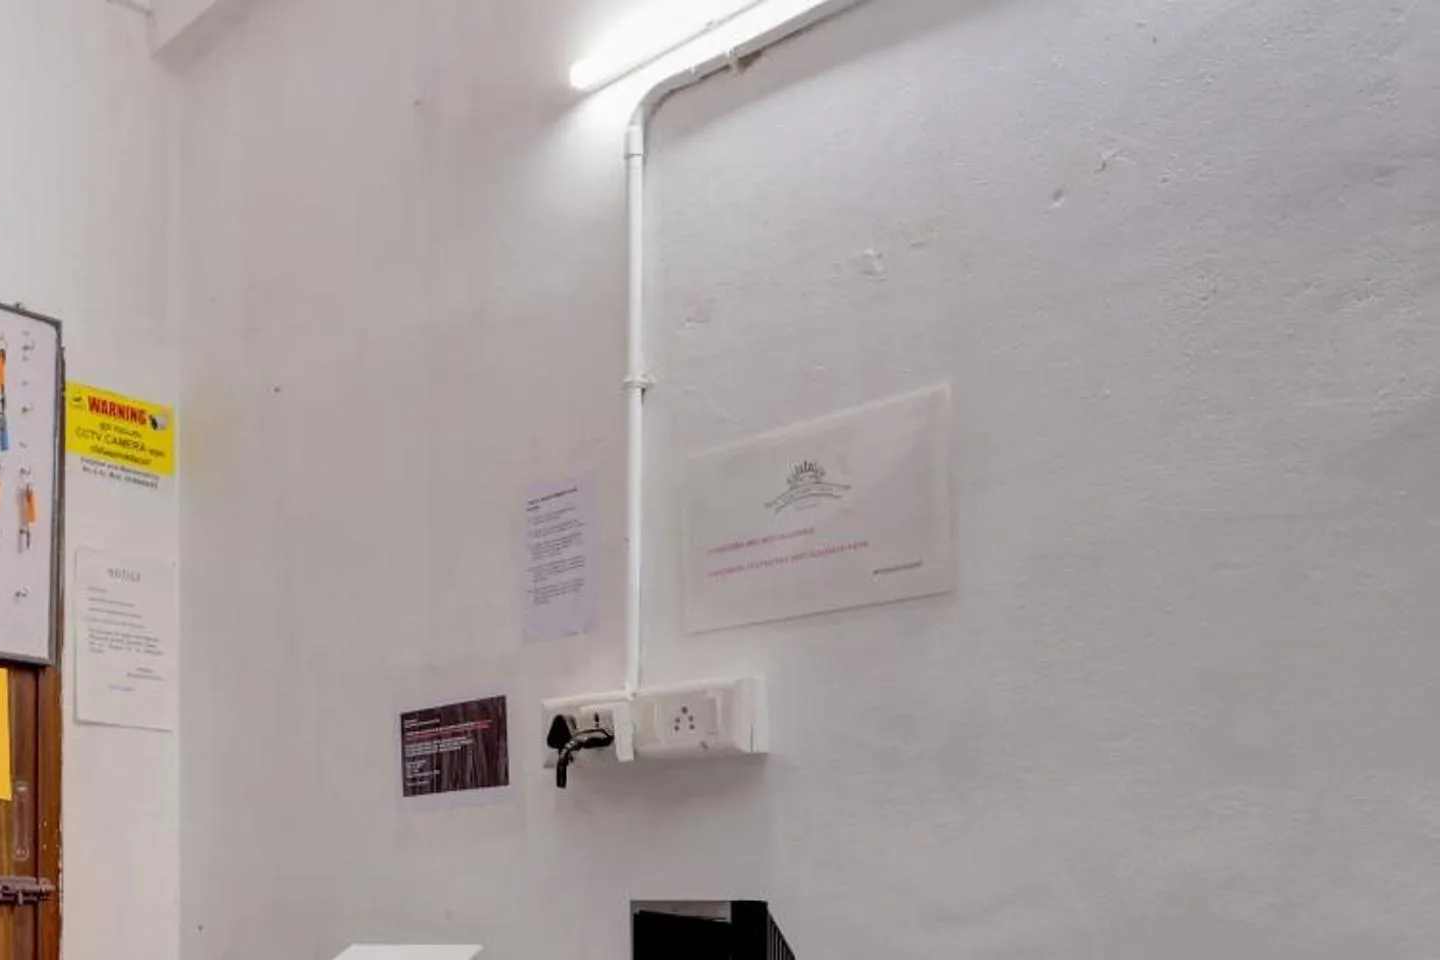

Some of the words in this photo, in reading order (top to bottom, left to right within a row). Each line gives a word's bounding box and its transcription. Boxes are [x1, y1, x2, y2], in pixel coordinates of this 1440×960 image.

[87, 395, 147, 426] WARNING
[75, 426, 102, 441] CCTV
[103, 434, 146, 452] CAMERA
